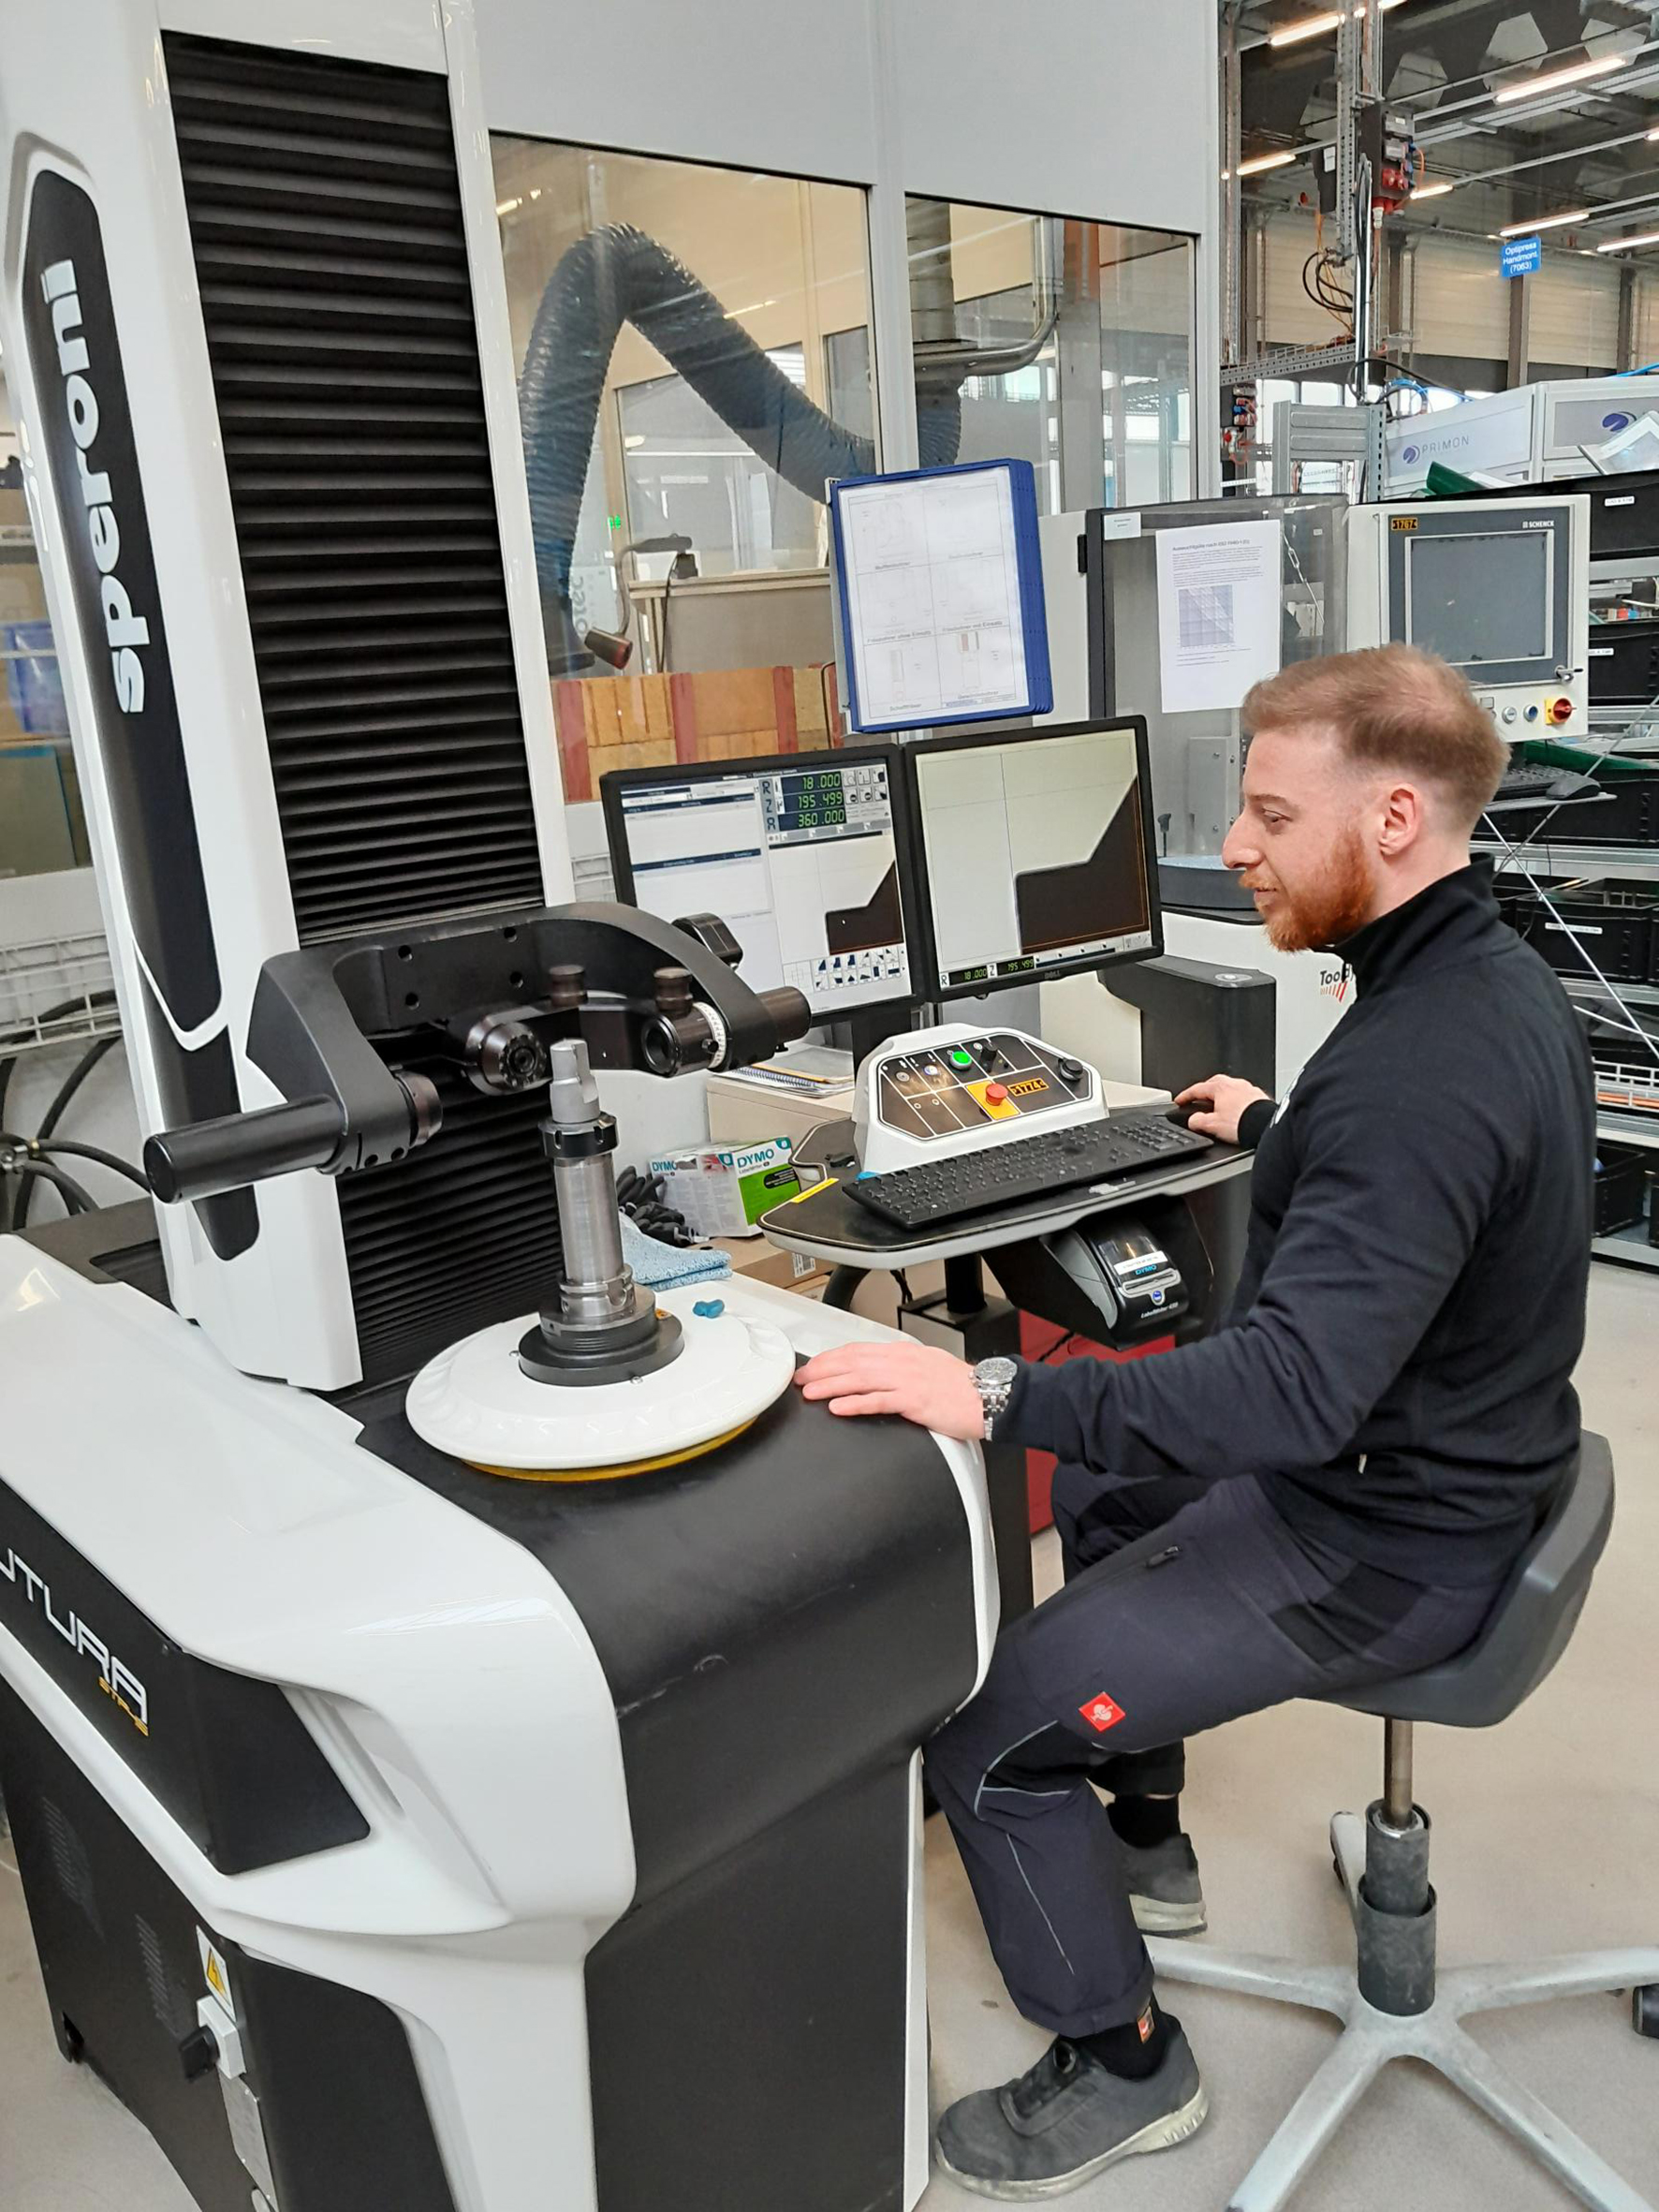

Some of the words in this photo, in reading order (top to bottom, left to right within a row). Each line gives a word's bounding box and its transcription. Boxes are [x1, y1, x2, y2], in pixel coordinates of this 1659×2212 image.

[1421, 435, 1470, 454] PRIMON
[40, 259, 151, 715] speroni
[1528, 519, 1555, 528] SCHENCK
[761, 780, 771, 794] R
[765, 799, 773, 813] Z
[940, 974, 947, 985] R
[989, 965, 995, 977] Z
[736, 1147, 775, 1169] DYMO
[1135, 1263, 1157, 1276] DYMO
